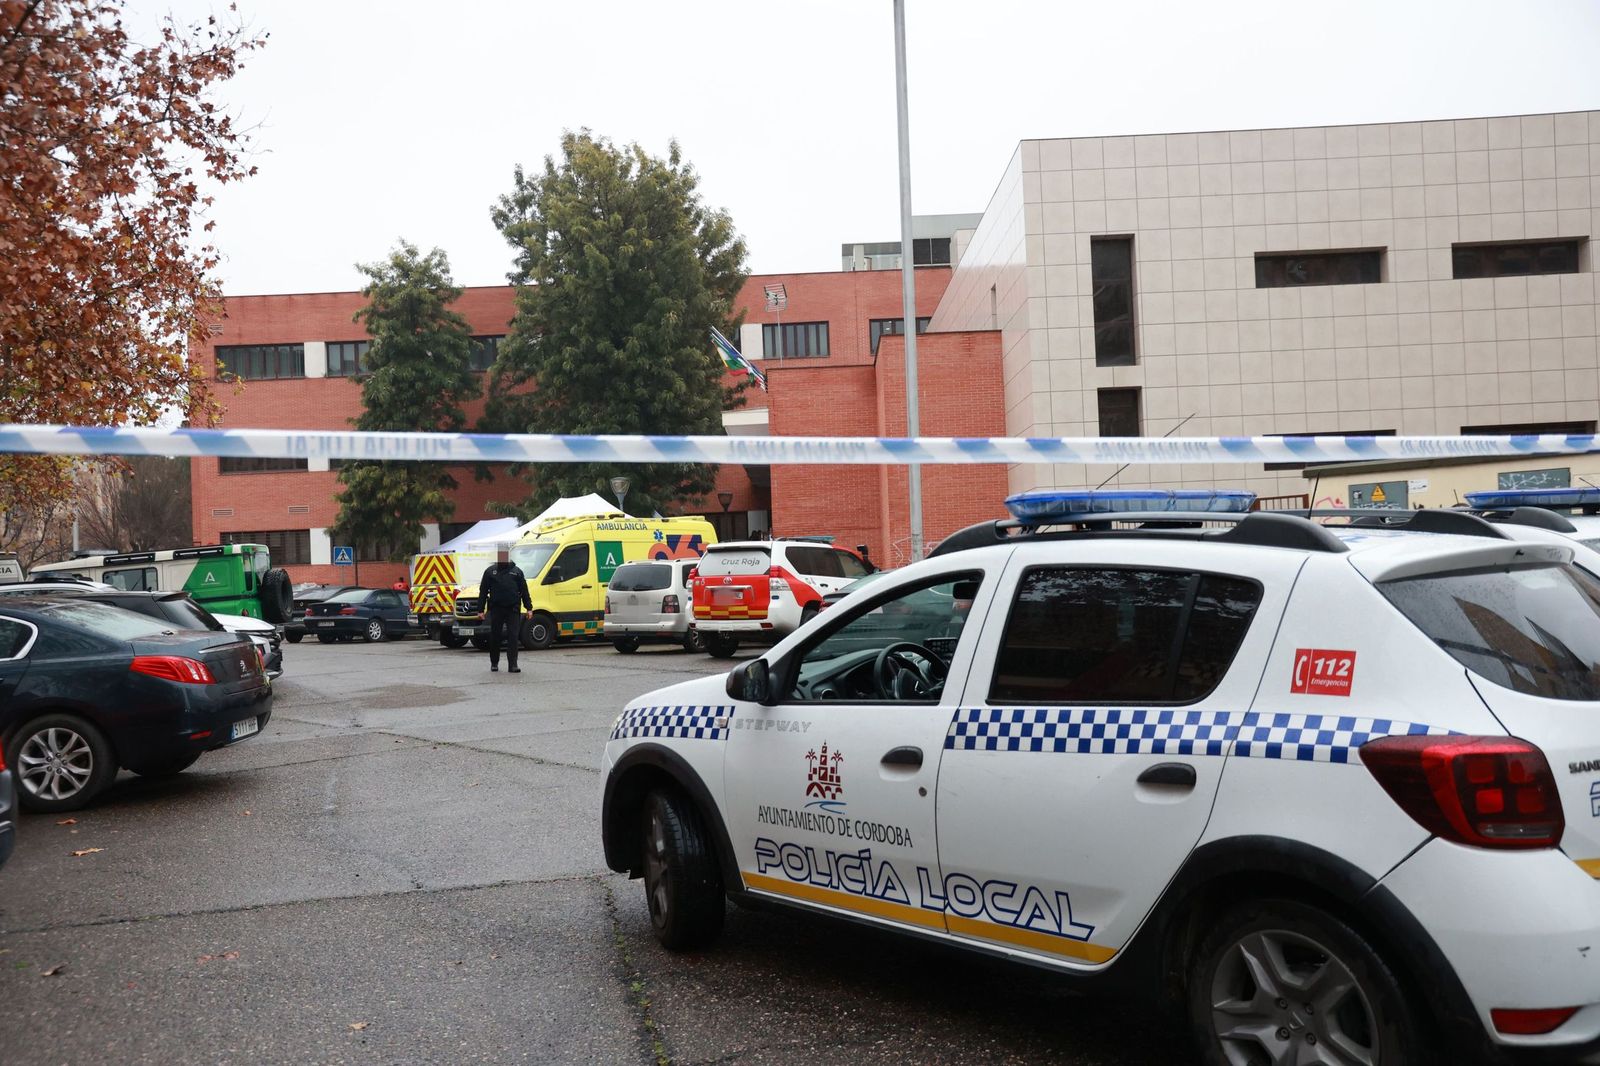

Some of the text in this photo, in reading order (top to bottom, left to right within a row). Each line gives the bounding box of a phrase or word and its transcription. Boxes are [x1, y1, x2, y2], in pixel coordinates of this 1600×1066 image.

[596, 522, 648, 531] AMBULANCIA
[721, 558, 761, 566] Cruz Roja
[1314, 657, 1351, 676] 112
[1311, 677, 1349, 687] Emergencias
[735, 718, 812, 733] STEPWAY
[758, 804, 914, 848] AYUNTAMIENTO DE CORDOBA
[755, 838, 1096, 942] POLICÍA LOCAL
